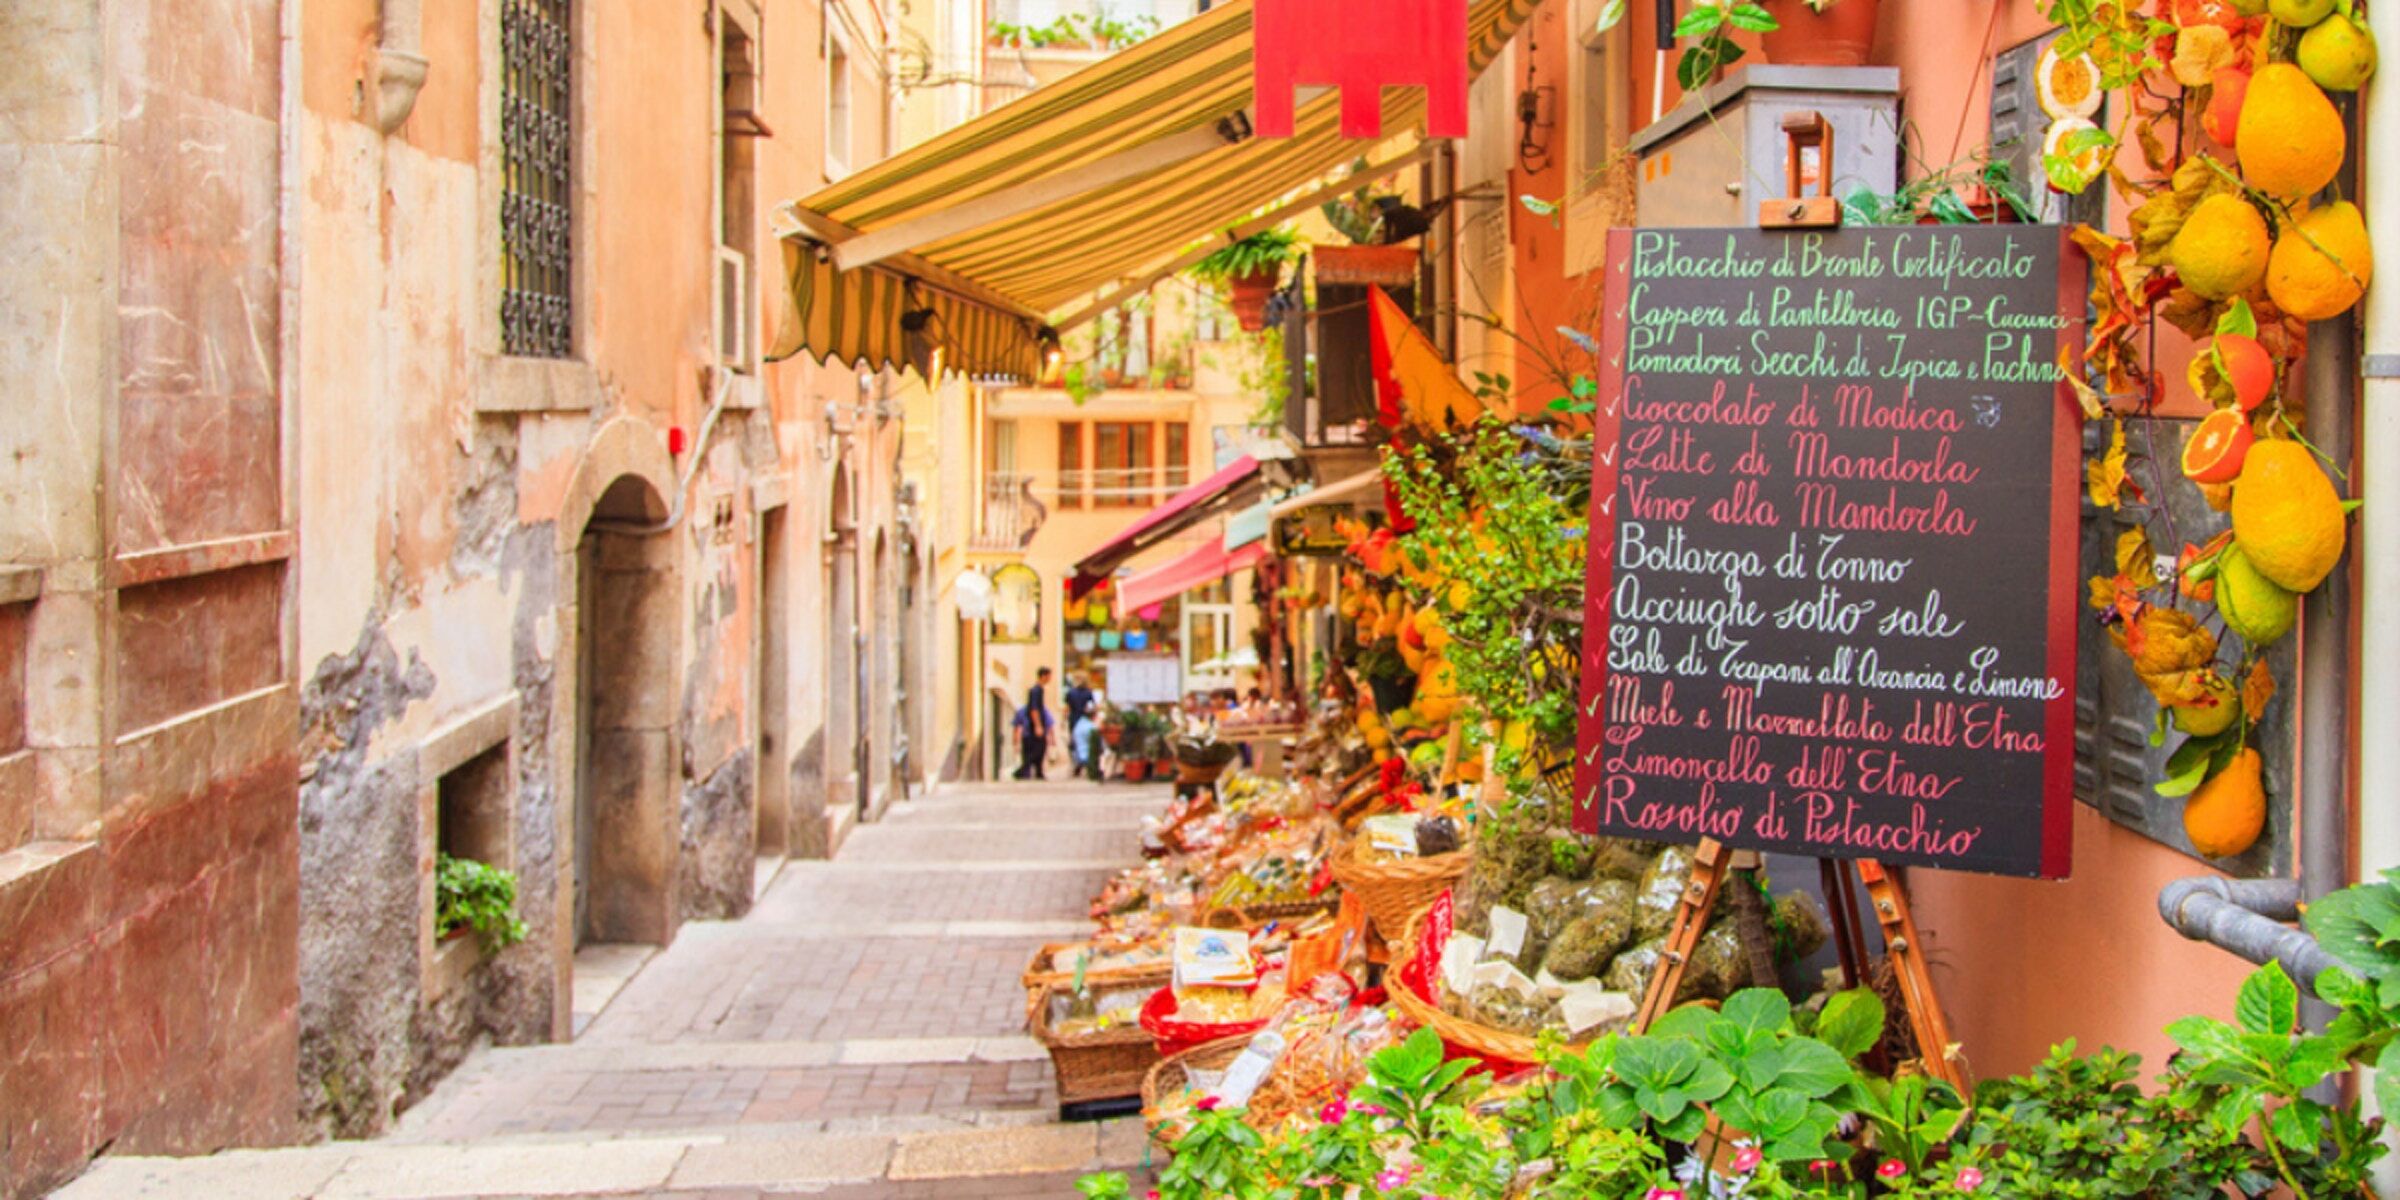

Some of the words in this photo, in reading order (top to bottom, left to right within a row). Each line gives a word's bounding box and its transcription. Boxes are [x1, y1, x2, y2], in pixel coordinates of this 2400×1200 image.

[1633, 232, 1767, 278] Pistacchio
[1770, 235, 1796, 277] di
[1801, 232, 1884, 278] Bronte
[1892, 232, 2036, 291] Certificato
[1629, 282, 1728, 344] Capperi
[1736, 290, 1762, 327] di
[1769, 286, 1902, 328] Pantelleria
[1627, 326, 1742, 373] Pomodori
[1751, 329, 1839, 377] Secchi
[1843, 333, 1872, 378] di
[1966, 361, 1980, 380] e
[1623, 374, 1776, 426] Cioccolato
[1785, 383, 1820, 427] di
[1834, 384, 1965, 432] Modica
[1622, 424, 1716, 476] Latte
[1730, 429, 1771, 477] di
[1788, 430, 1981, 483] Mandorla
[1621, 473, 1696, 521] Vino
[1707, 479, 1781, 528] alla
[1795, 481, 1978, 536] Mandorla
[1619, 522, 1766, 593] Bottarga
[1774, 531, 1808, 578] di
[1816, 533, 1914, 582] Tonno
[1615, 573, 1766, 651] Acciughe
[1773, 584, 1876, 634] sotto
[1878, 589, 1966, 636] sale
[1606, 623, 1669, 674] Sale
[1676, 635, 1708, 676] di
[1719, 636, 1812, 698] Trapani
[1953, 670, 1966, 693] e
[1969, 646, 2064, 700] Limone
[1607, 673, 1684, 727] Miele
[1693, 708, 1711, 730] e
[1722, 684, 1894, 742] Marmellata
[1604, 725, 1776, 784] Limoncello
[1602, 774, 1744, 837] Rosolio
[1754, 790, 1789, 841] di
[1793, 791, 1981, 856] Pistacchio
